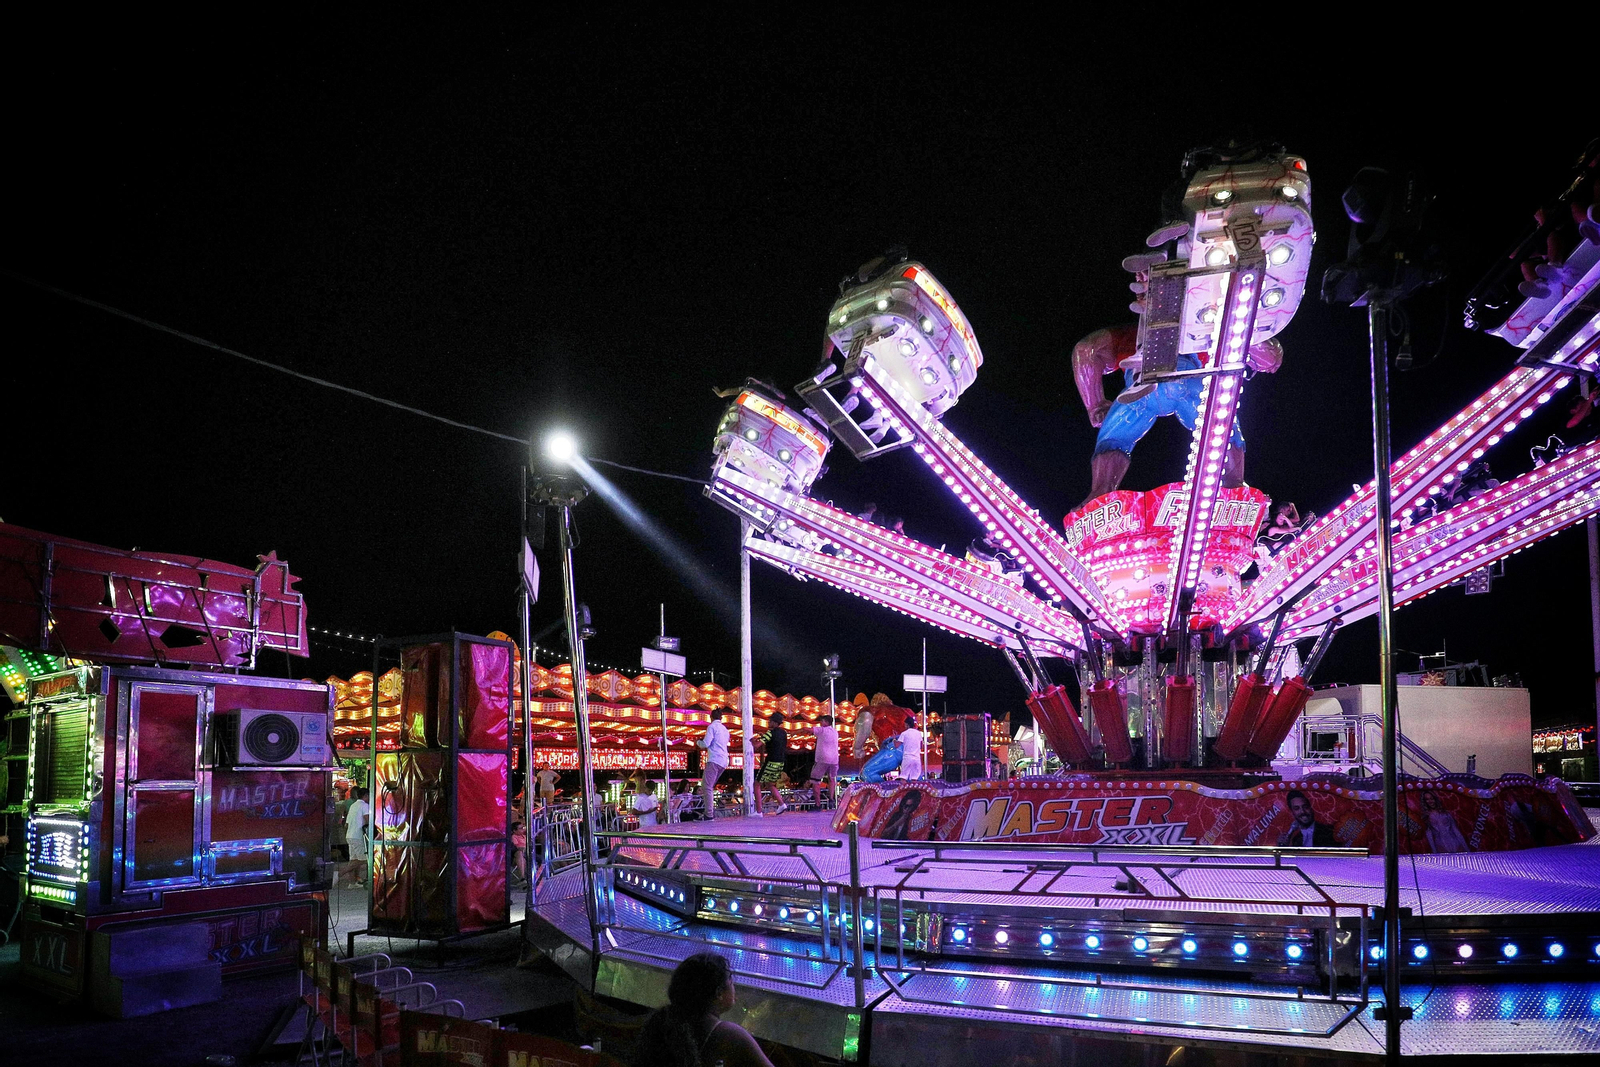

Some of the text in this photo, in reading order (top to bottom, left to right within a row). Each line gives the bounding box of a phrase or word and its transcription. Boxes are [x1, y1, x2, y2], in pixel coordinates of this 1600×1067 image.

[1232, 224, 1259, 252] 5
[1094, 513, 1139, 544] XXL
[1286, 503, 1367, 572] MASTER XXL
[931, 560, 993, 596] MASTER
[217, 782, 309, 813] MASTER
[259, 800, 305, 820] XXL
[958, 796, 1172, 843] MASTER
[1096, 823, 1197, 846] XXL
[1244, 803, 1281, 847] MALUMA
[1469, 803, 1490, 849] BEYONCE
[31, 932, 74, 976] XXL
[209, 933, 281, 966] XXL
